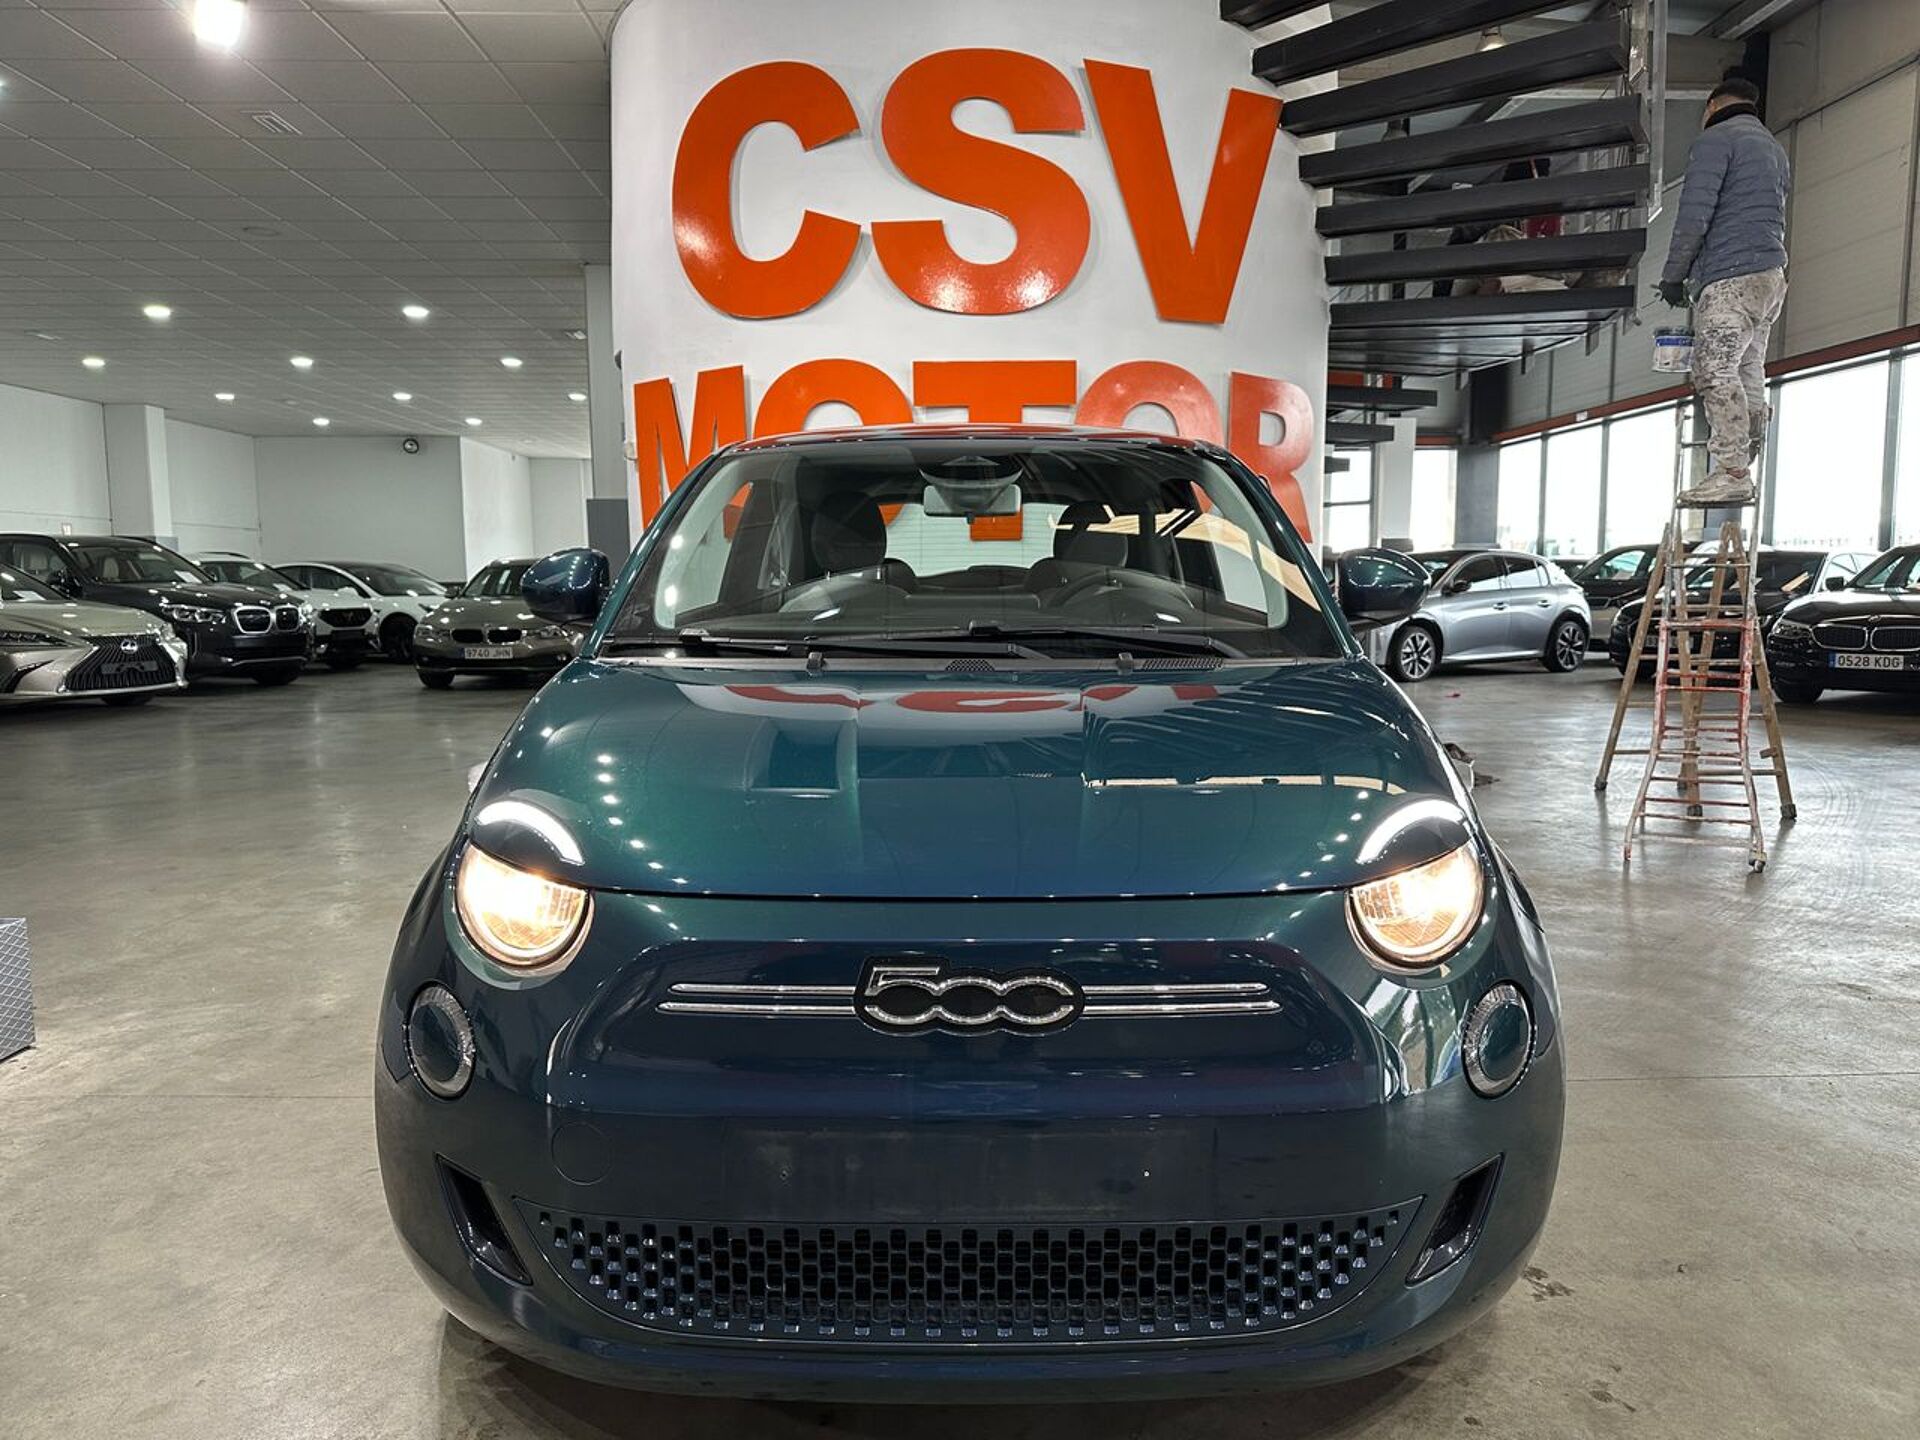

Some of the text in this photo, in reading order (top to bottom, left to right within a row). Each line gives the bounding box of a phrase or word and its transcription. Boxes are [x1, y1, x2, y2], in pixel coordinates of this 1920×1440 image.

[672, 48, 1284, 324] CSV
[1839, 656, 1899, 668] 0528 KDG
[865, 967, 1074, 1024] 500
